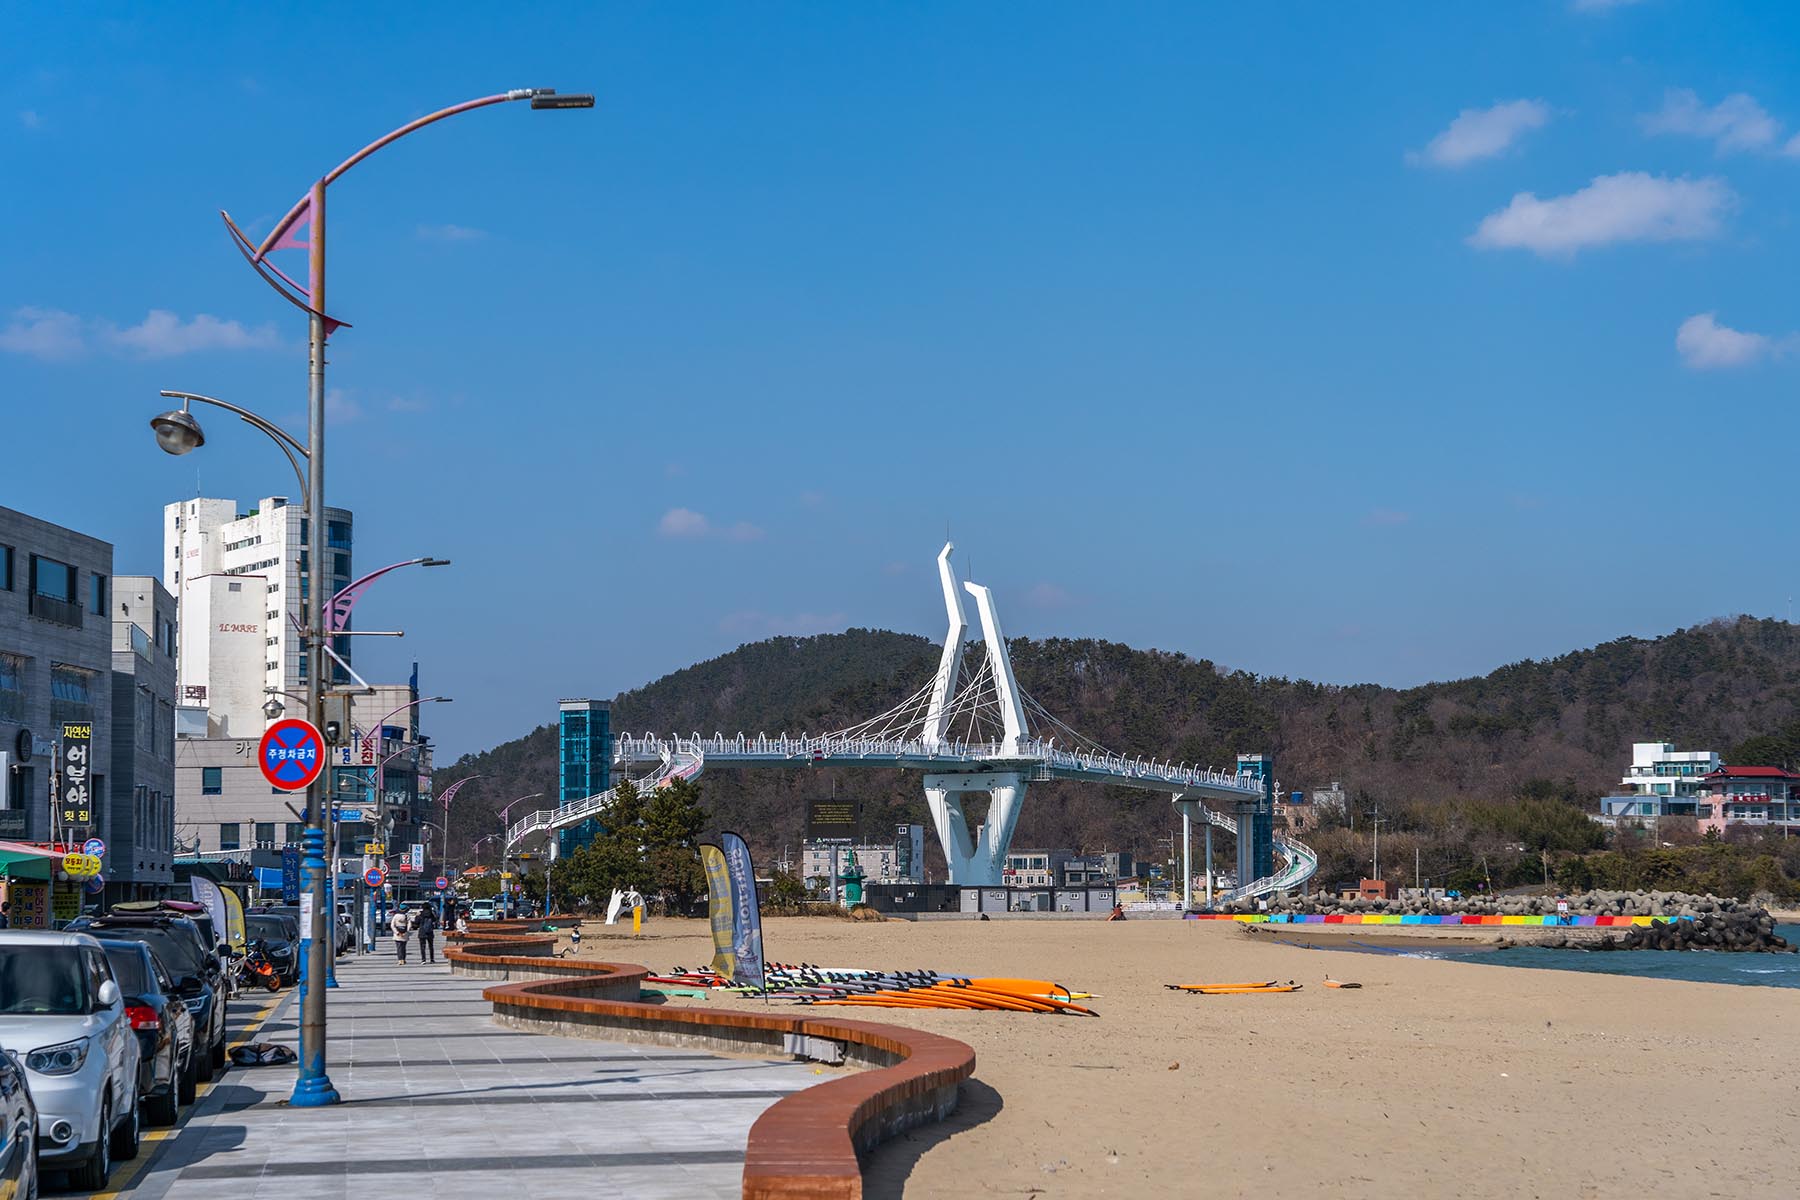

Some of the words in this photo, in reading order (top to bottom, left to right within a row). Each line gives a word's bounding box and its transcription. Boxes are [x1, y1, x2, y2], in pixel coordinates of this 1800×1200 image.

[230, 623, 259, 634] MARE
[63, 725, 91, 739] 자연산
[268, 748, 316, 760] 주정차금지
[66, 744, 88, 806] 어부야
[64, 810, 89, 822] 횟집
